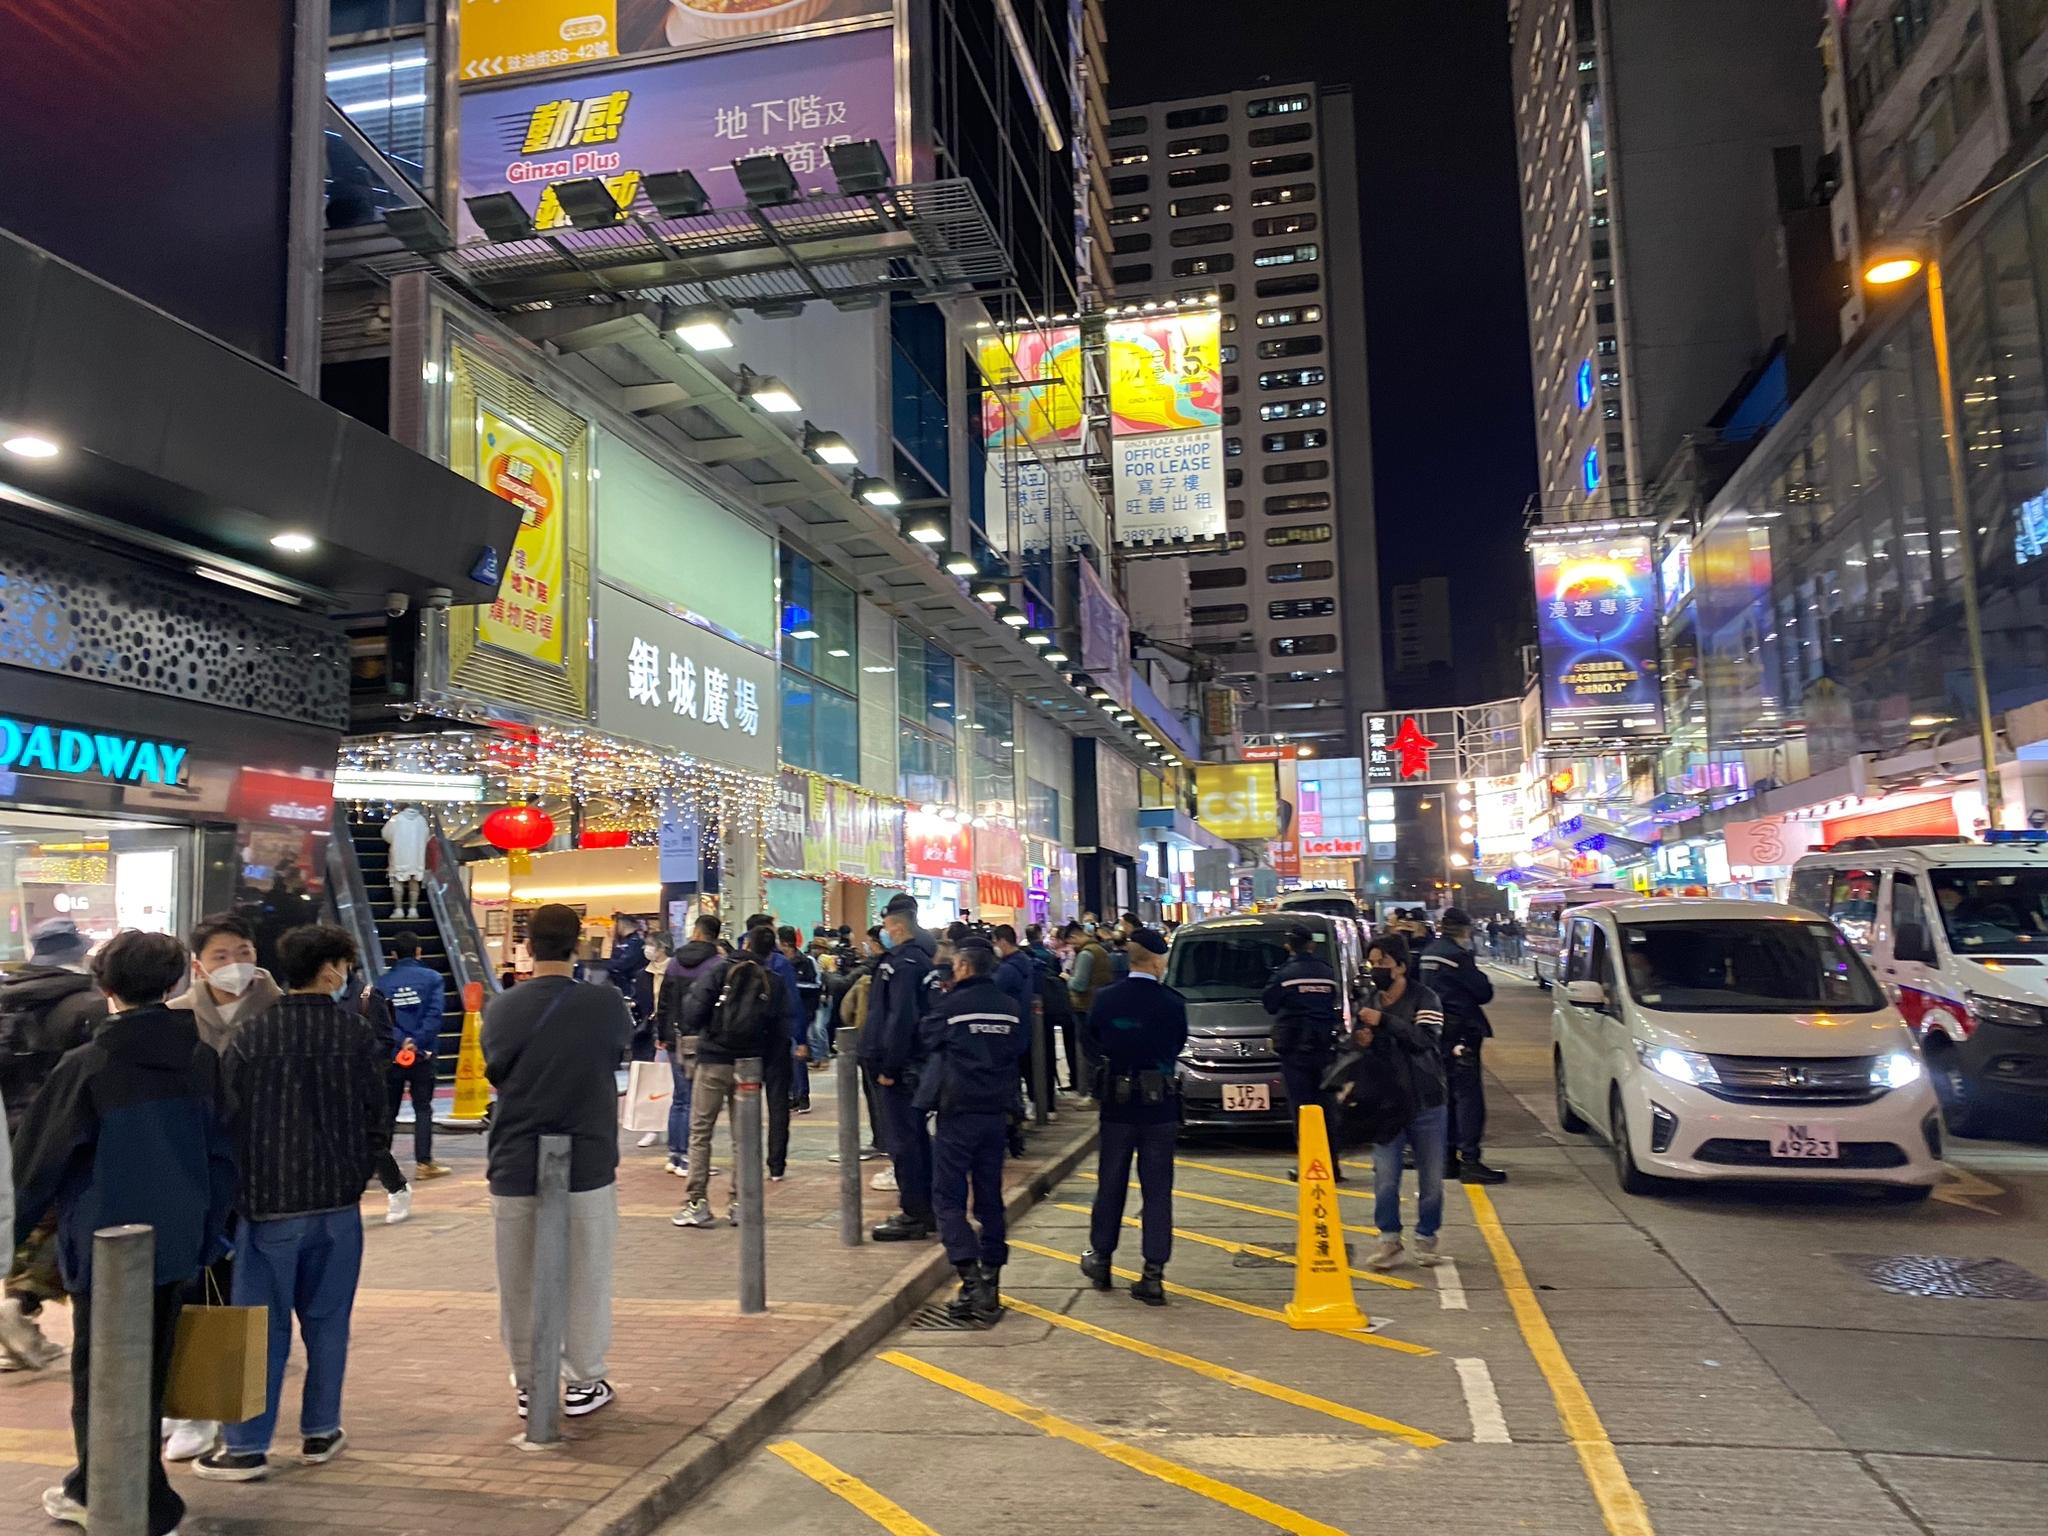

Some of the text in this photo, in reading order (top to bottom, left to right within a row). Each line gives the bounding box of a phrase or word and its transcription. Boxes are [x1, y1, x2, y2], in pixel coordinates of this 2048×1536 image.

[521, 90, 631, 155] 動感
[714, 95, 847, 140] 地下階及
[507, 152, 620, 183] Ginza Plus
[1124, 443, 1210, 461] OFFICE SHOP
[1125, 456, 1211, 477] FOR LEASE
[1137, 474, 1200, 496] 寫字樓
[1123, 526, 1189, 542] 3899 2133
[1548, 598, 1644, 619] 漫遊專家
[627, 636, 760, 737] 銀城廣場
[1303, 836, 1361, 854] Locker
[1236, 1085, 1255, 1098] TP
[1226, 1097, 1267, 1110] 3472
[1777, 1140, 1832, 1157] 4923
